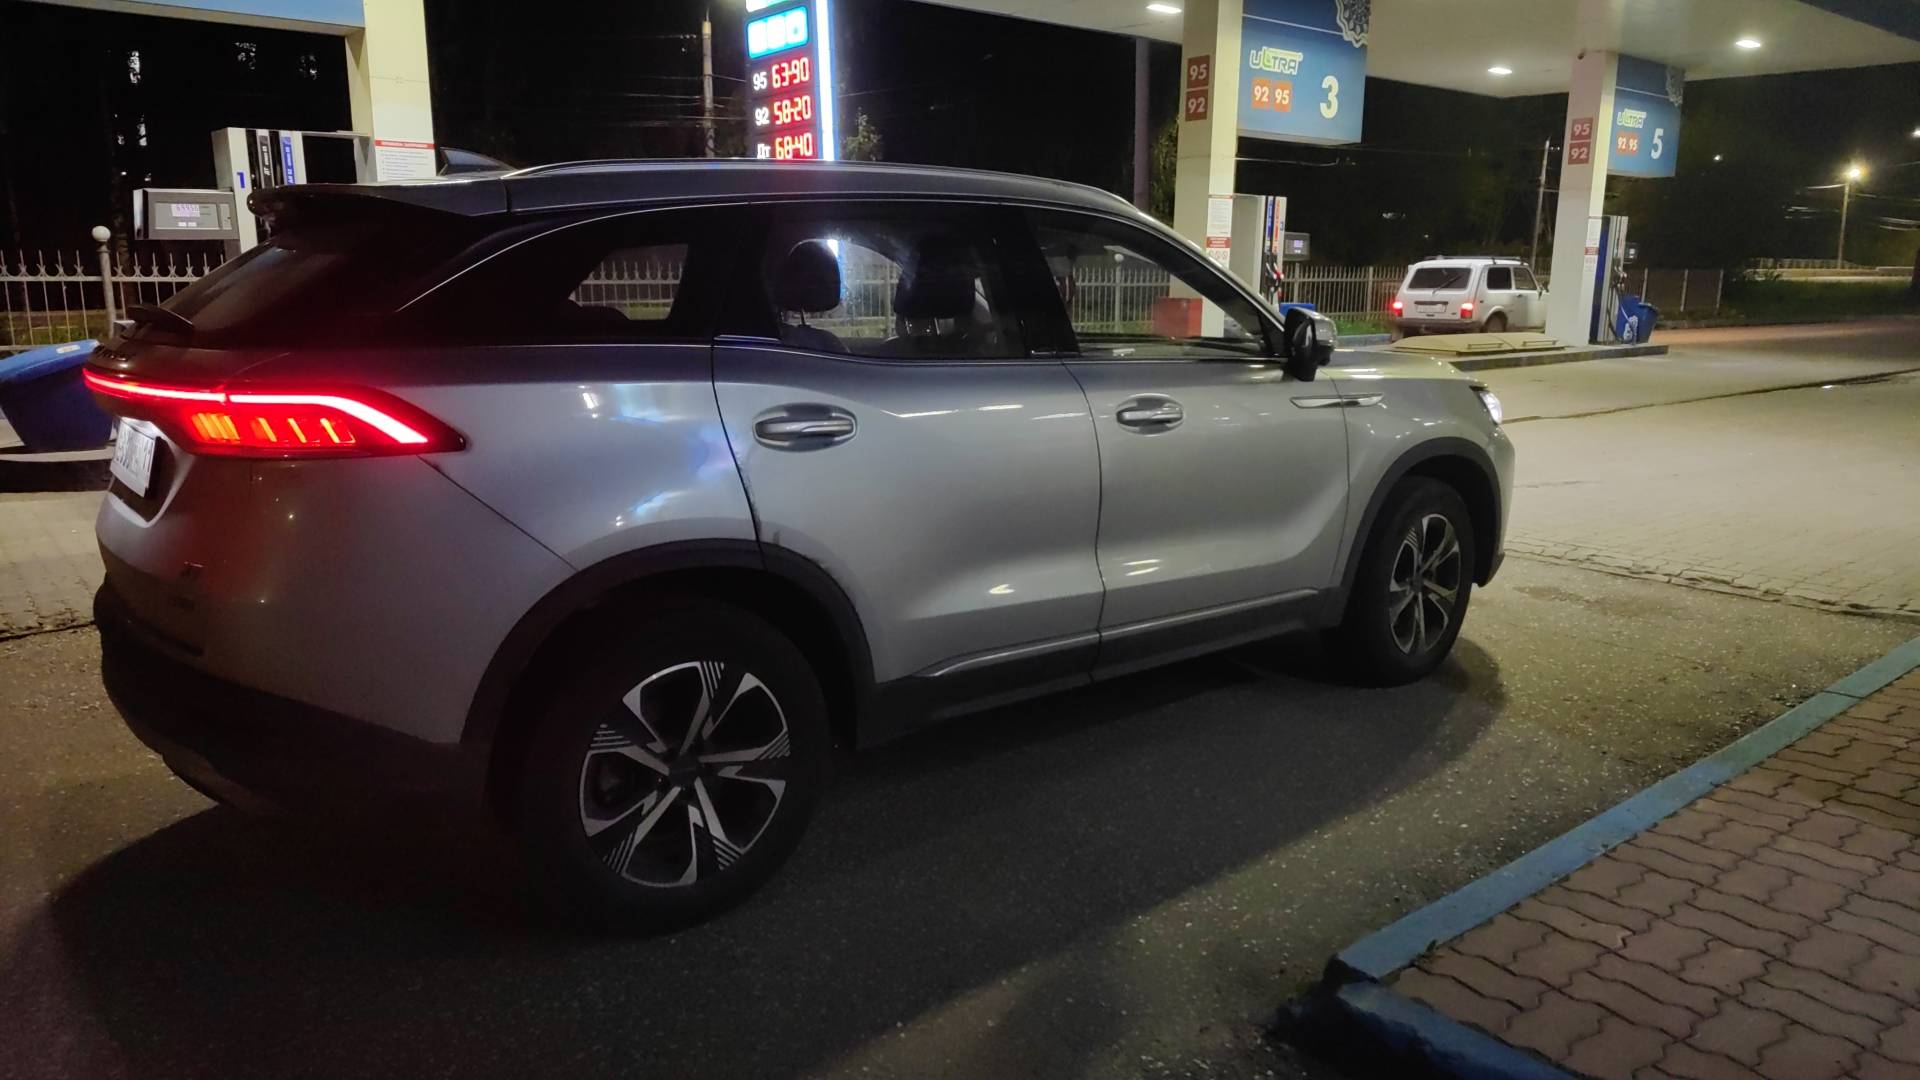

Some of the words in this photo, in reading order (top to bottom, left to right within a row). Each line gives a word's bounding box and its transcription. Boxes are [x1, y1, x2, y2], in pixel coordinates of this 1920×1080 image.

[1250, 47, 1301, 75] ULTRA
[753, 71, 768, 91] 95
[1189, 64, 1207, 81] 95
[1253, 85, 1269, 103] 92
[1274, 87, 1290, 105] 95
[1319, 75, 1339, 119] 3
[1188, 97, 1206, 114] 92
[754, 106, 770, 126] 92
[1573, 123, 1590, 136] 95
[1618, 136, 1626, 150] 92
[1629, 139, 1638, 151] 95
[1650, 128, 1664, 160] 5
[1570, 147, 1588, 160] 92
[237, 172, 245, 189] 1
